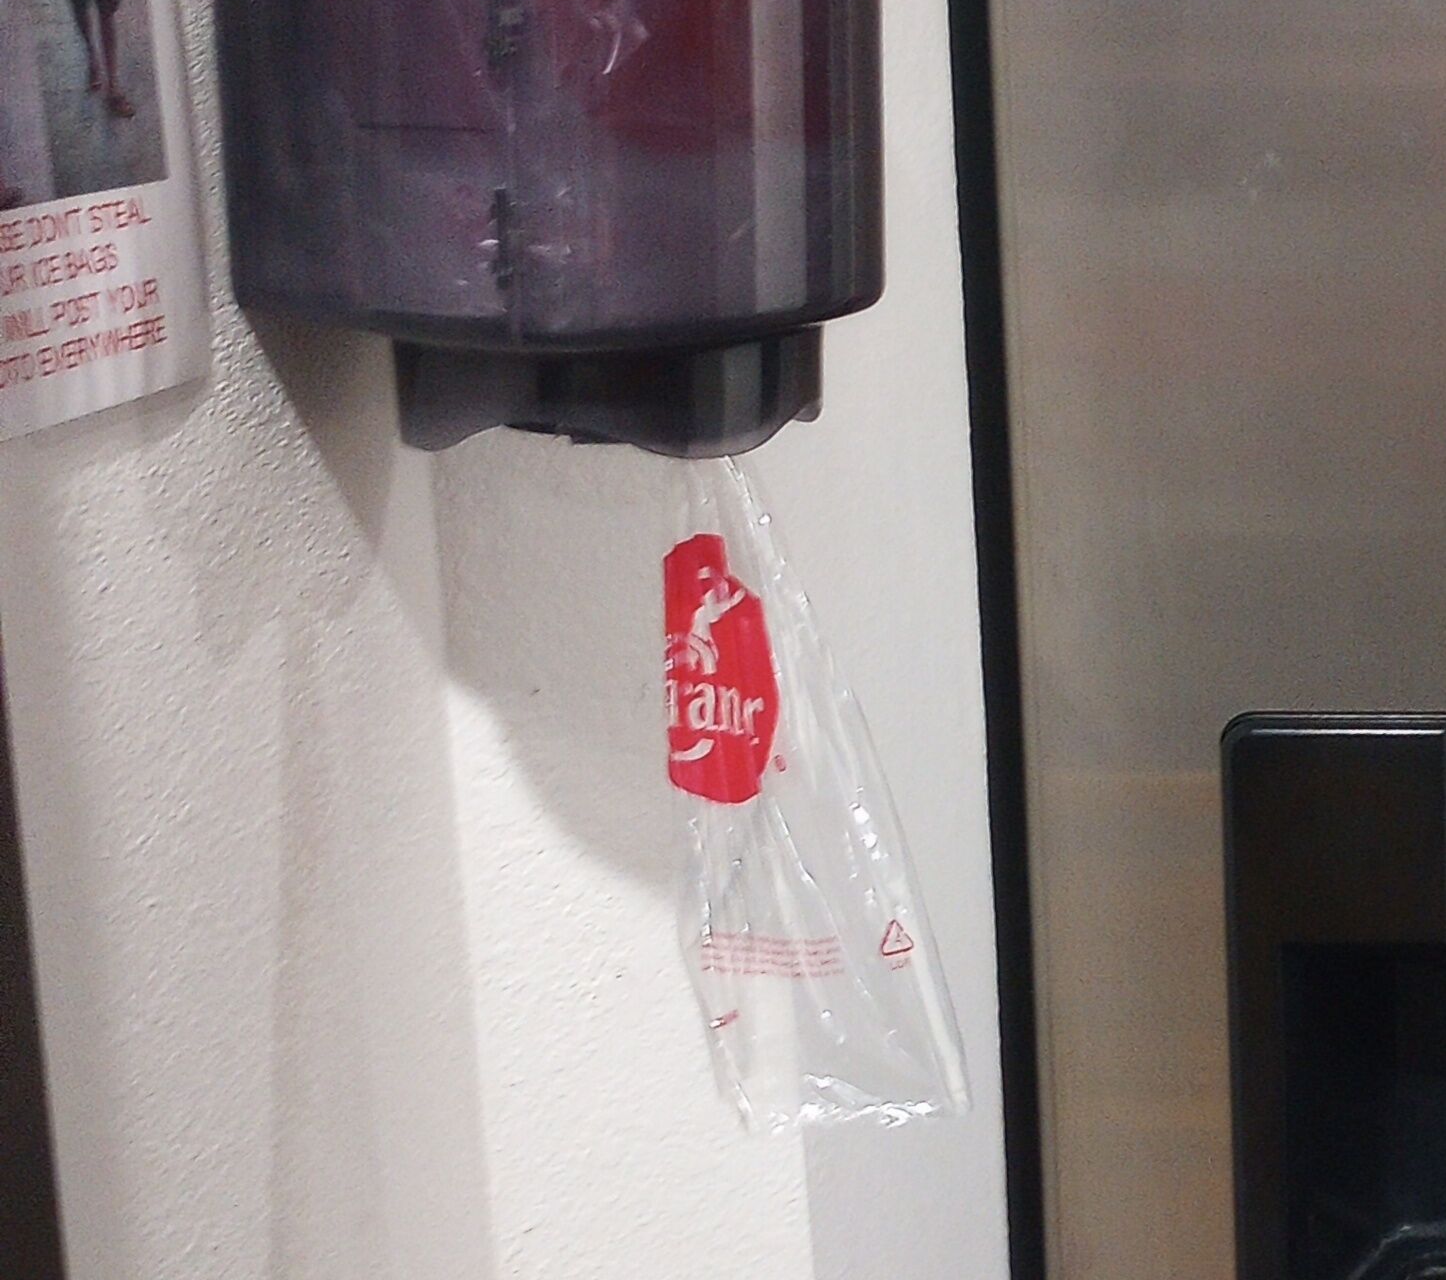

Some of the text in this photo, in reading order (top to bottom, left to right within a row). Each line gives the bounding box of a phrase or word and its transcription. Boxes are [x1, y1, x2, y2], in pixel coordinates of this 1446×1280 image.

[88, 196, 152, 234] STEAL
[63, 242, 119, 280] BAGS
[50, 291, 101, 328] POST
[106, 277, 161, 315] YOUR
[36, 314, 168, 377] EVERYWHERE
